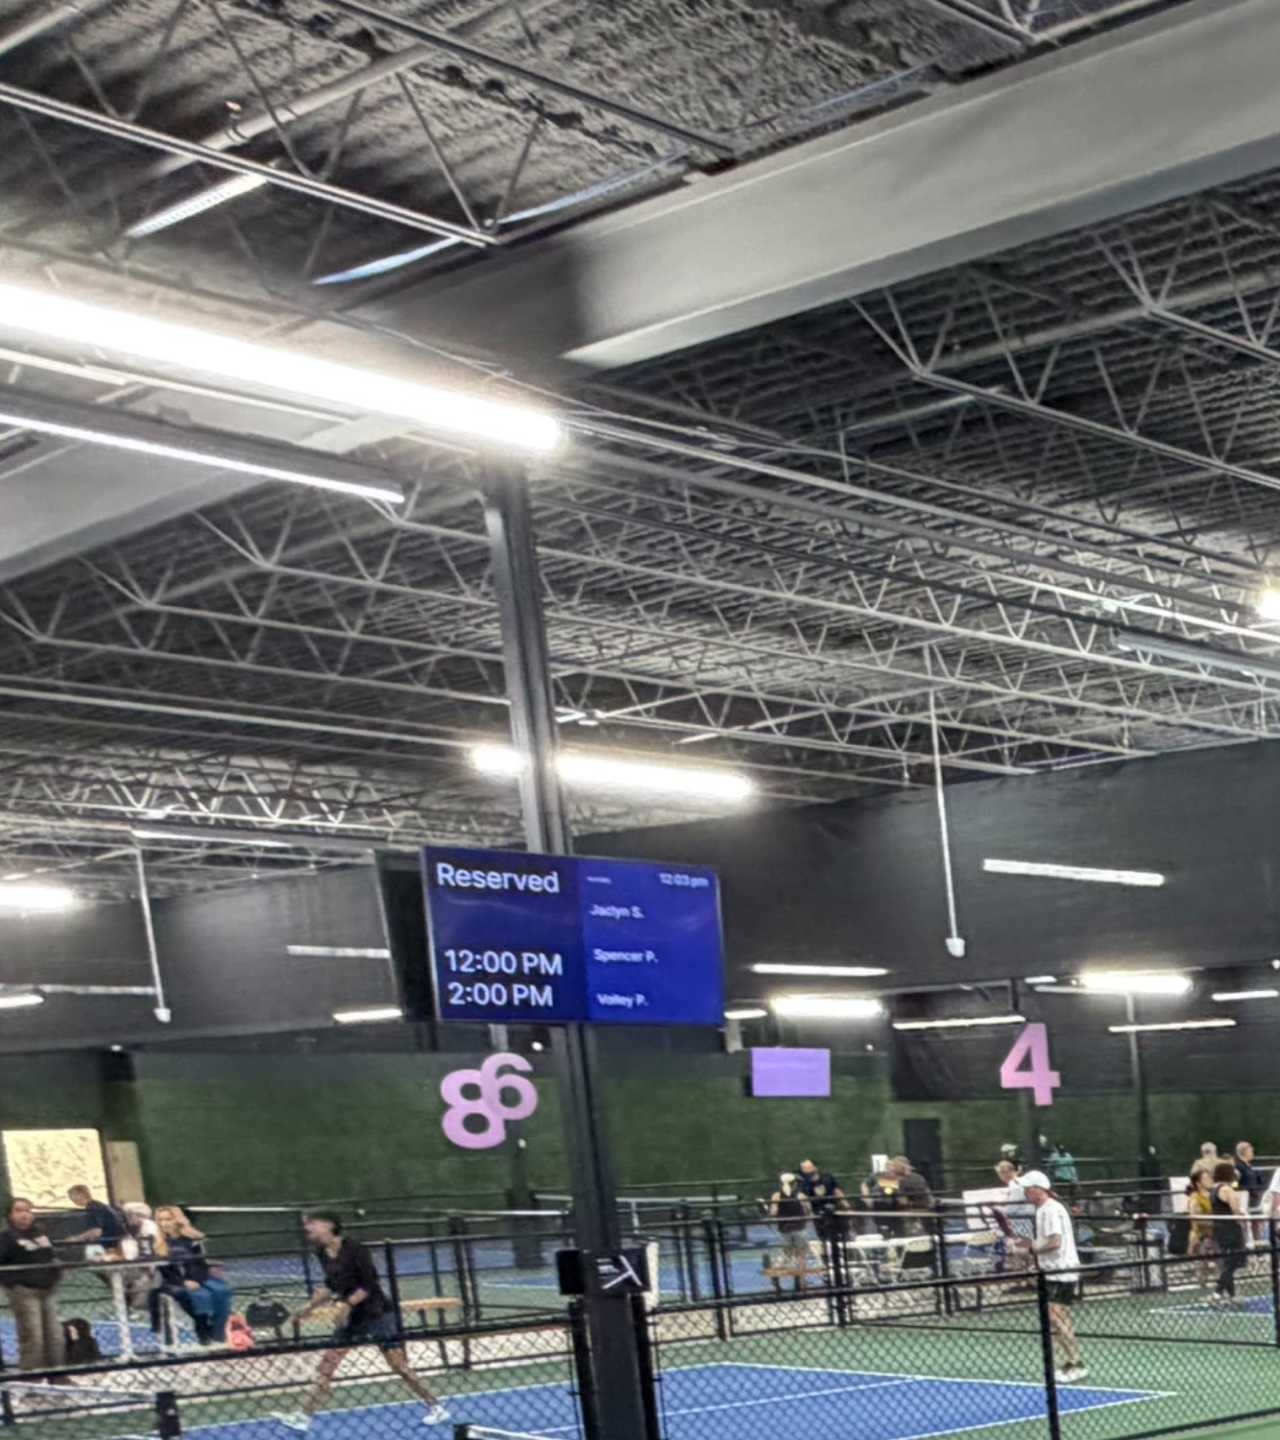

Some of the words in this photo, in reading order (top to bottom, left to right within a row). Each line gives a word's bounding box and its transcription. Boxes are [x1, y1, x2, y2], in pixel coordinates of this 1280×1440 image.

[436, 862, 560, 893] Reserved
[444, 949, 518, 975] 12:00
[522, 952, 563, 976] PM
[448, 982, 508, 1006] 2:00
[513, 984, 554, 1007] PM
[999, 1022, 1061, 1105] 4
